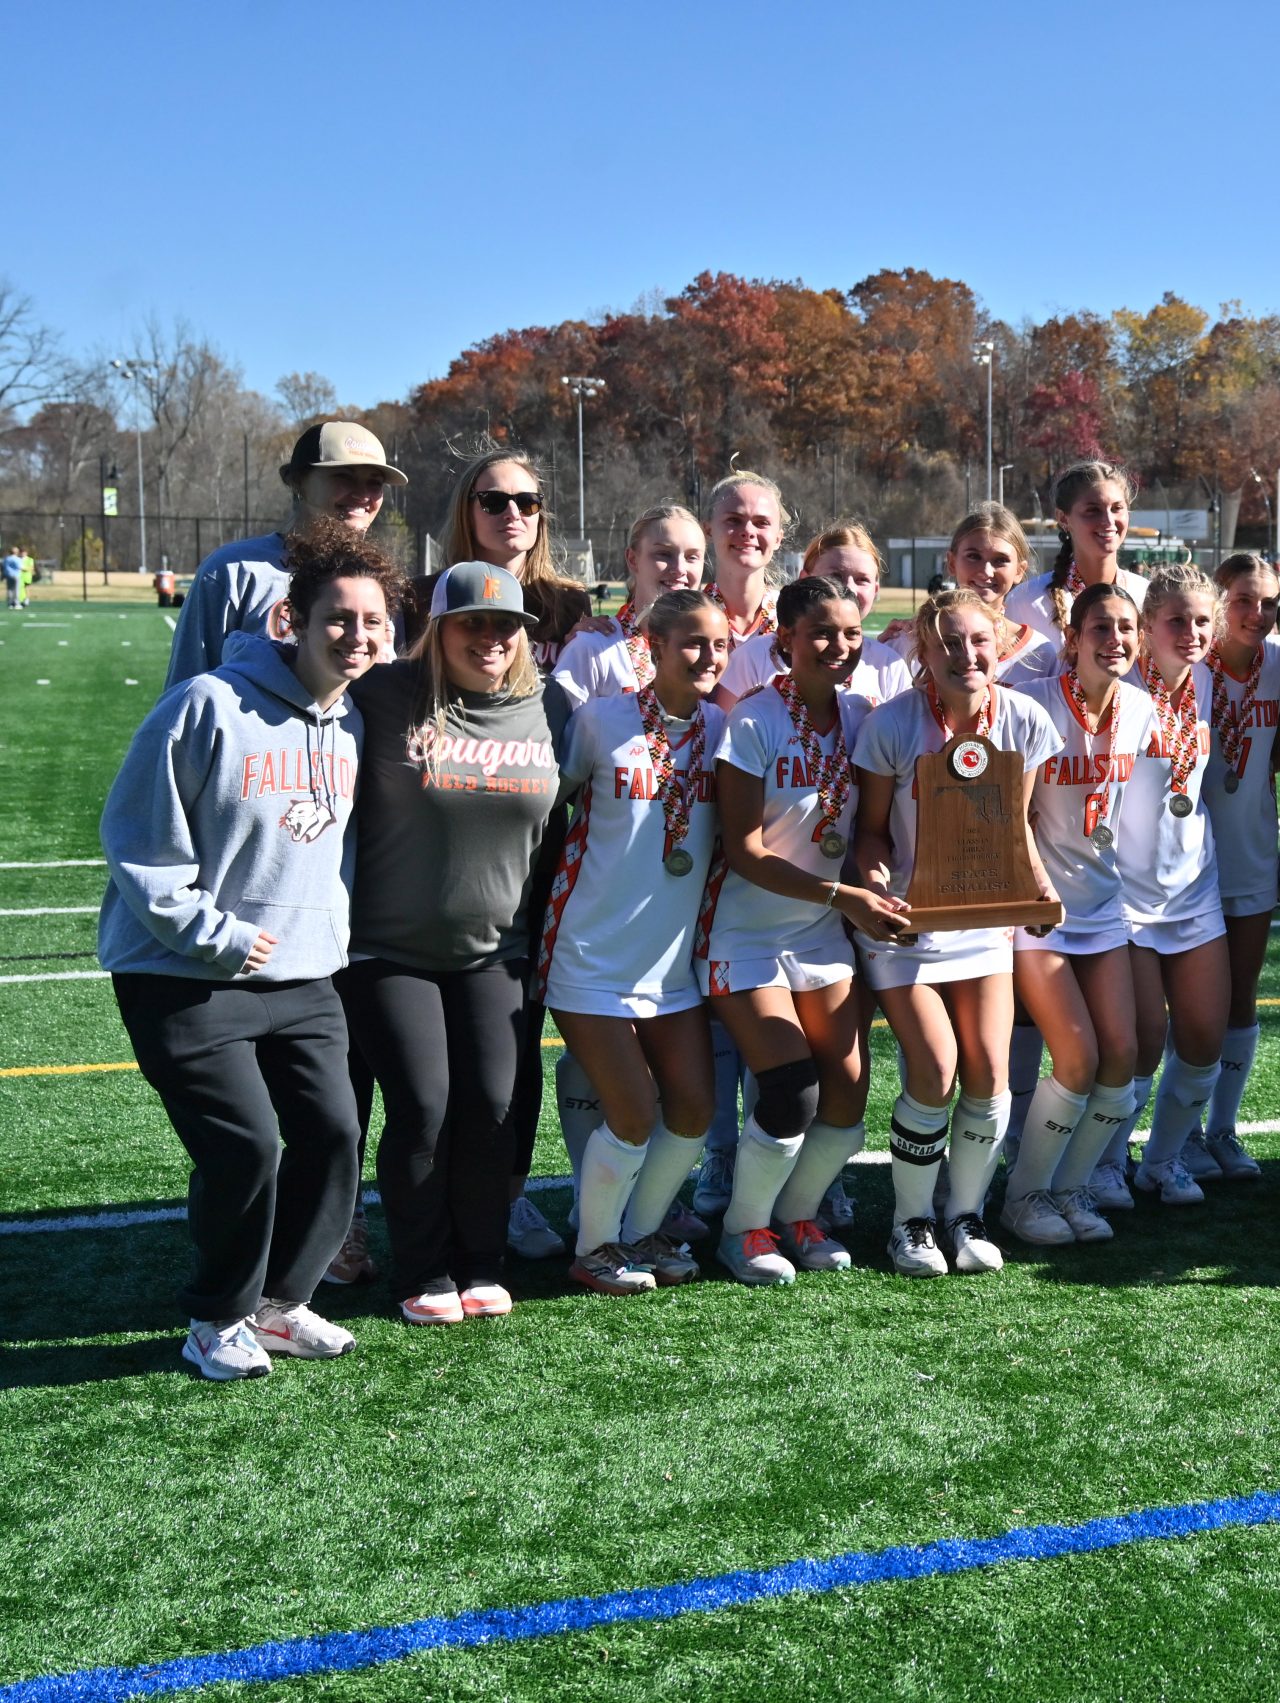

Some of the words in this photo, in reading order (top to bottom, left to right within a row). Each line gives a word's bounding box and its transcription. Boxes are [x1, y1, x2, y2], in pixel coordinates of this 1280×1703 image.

[405, 725, 553, 776] Cougars
[421, 772, 478, 791] FELD
[1220, 1060, 1244, 1071] TX
[565, 1097, 601, 1111] STX
[1044, 1119, 1075, 1135] STX
[1091, 1113, 1128, 1125] STX
[897, 1137, 937, 1156] CAPTAIN
